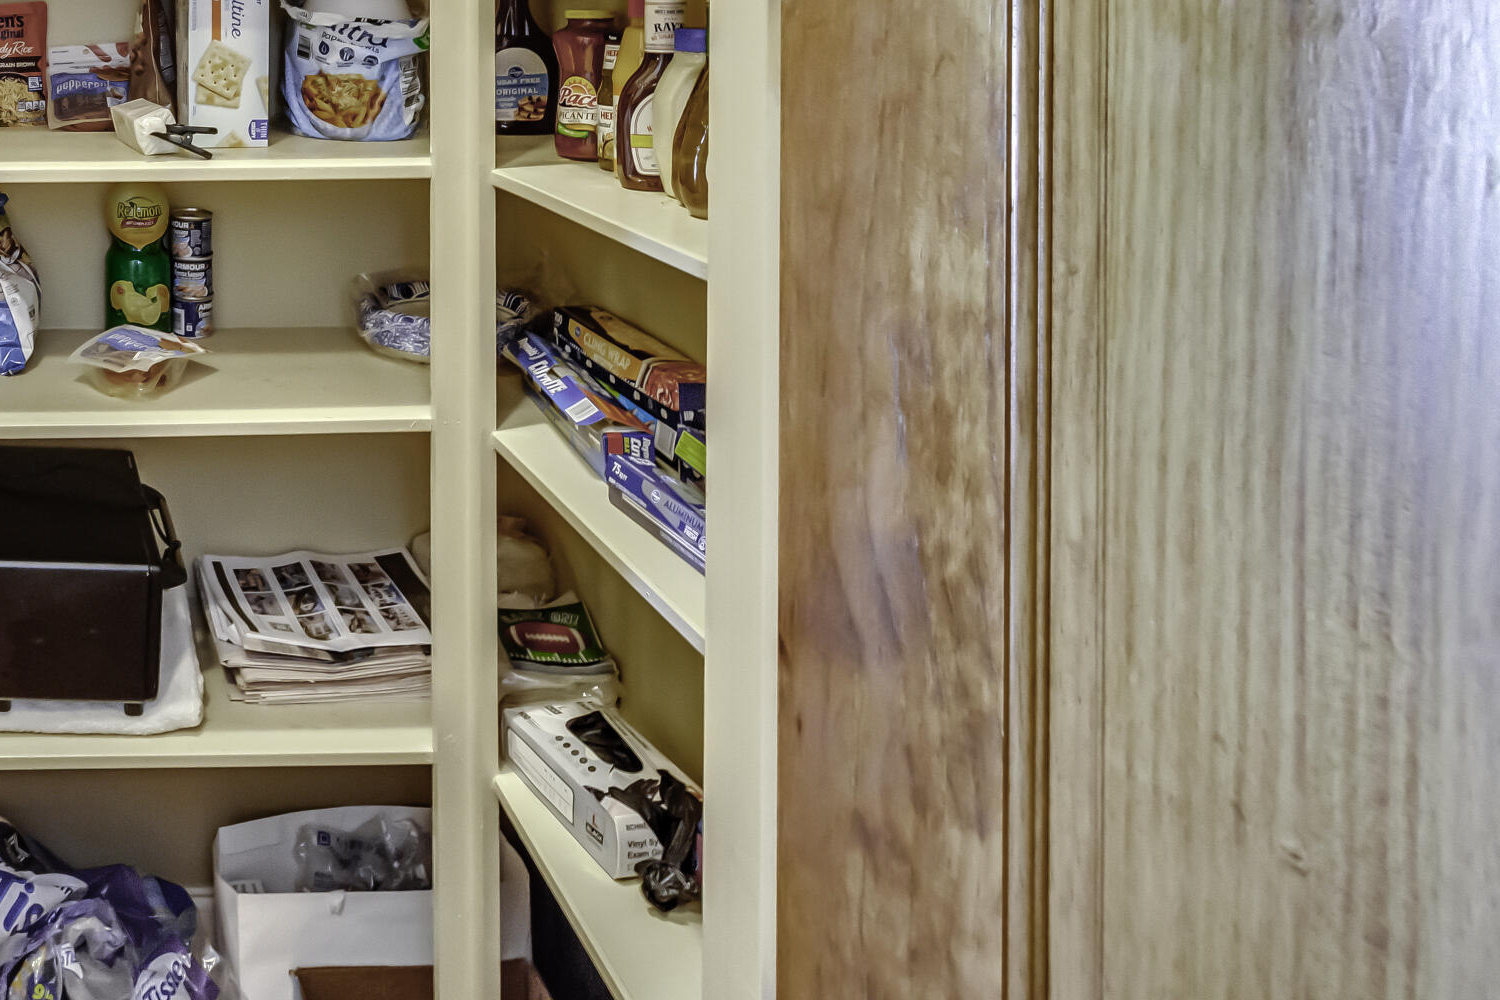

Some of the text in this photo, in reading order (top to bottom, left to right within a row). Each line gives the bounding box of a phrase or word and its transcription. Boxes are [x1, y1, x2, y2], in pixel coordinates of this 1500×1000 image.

[12, 42, 34, 55] Rice
[608, 347, 631, 370] WRAP
[612, 461, 622, 475] 75
[664, 500, 705, 535] ALUMINUM
[628, 839, 647, 848] Vinyl
[628, 850, 650, 859] Exam
